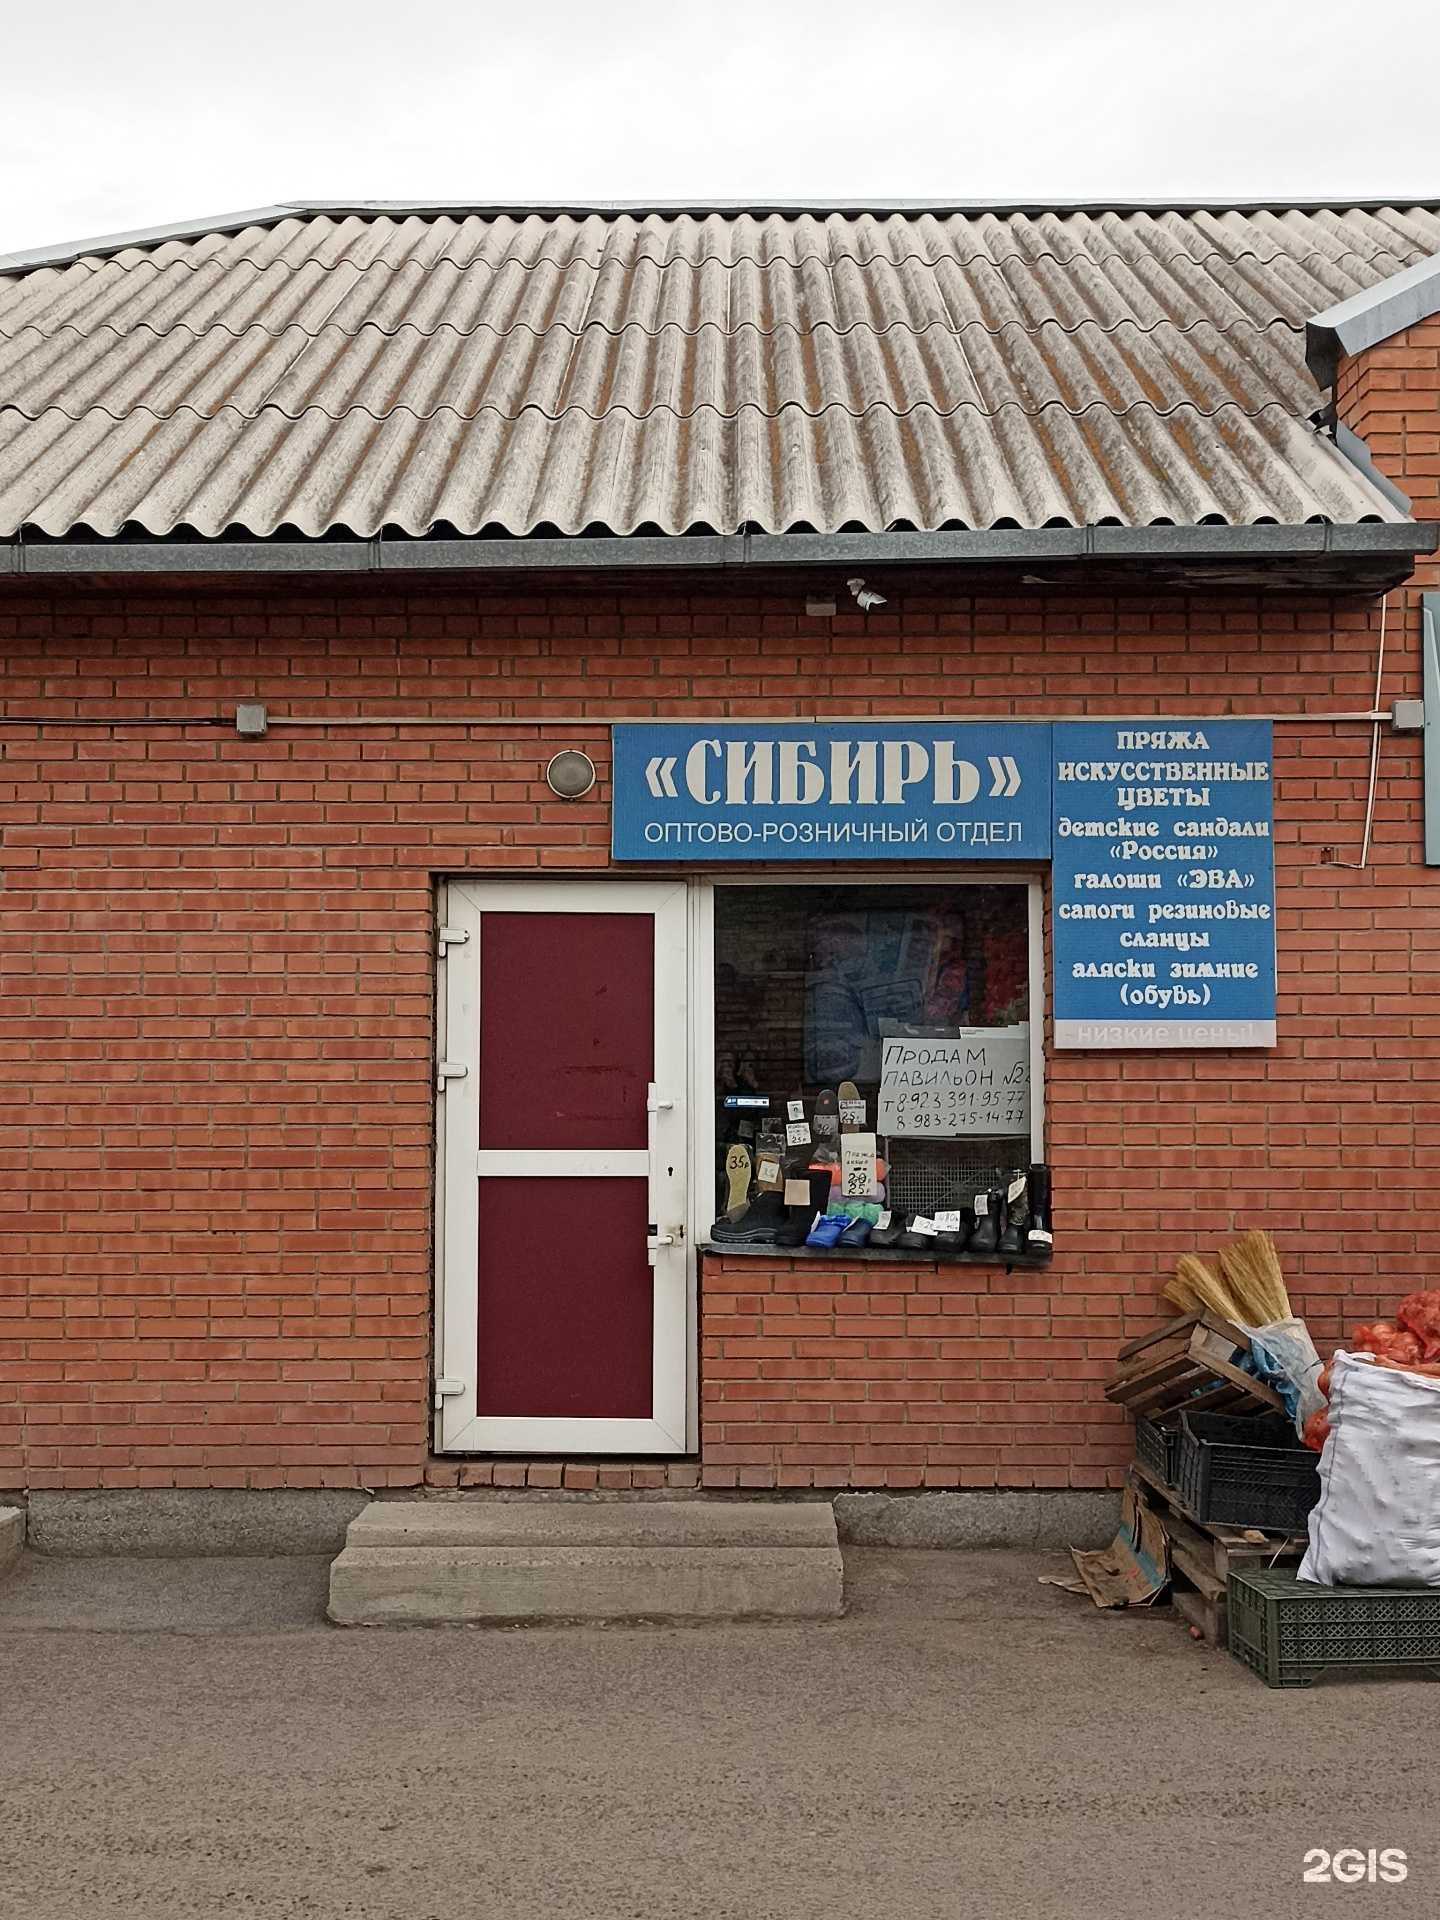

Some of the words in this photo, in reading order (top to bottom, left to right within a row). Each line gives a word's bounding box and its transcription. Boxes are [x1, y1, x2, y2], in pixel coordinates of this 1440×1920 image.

[1117, 731, 1210, 750] ПРЯЖА
[645, 739, 1022, 806] «СИБИРЬ»
[1058, 761, 1270, 781] ИСКУССТВЕННЫЕ
[1117, 787, 1210, 810] ЦВЕТЫ
[645, 819, 928, 843] ОПТОВО-РОЗНИЧНЫЙ
[936, 822, 1022, 845] ОТДЕЛ
[1058, 817, 1160, 836] детские
[1173, 817, 1270, 836] сандали
[1110, 840, 1218, 860] «Россия»
[1074, 873, 1161, 889] галоши
[1177, 869, 1255, 889] «ЭВА»
[1058, 903, 1135, 920] сапоги
[1148, 899, 1271, 923] резиновые
[1120, 931, 1210, 951] сланцы
[1072, 959, 1156, 978] аляски
[1170, 962, 1258, 978] зимние
[1120, 983, 1211, 1009] (обувь)
[883, 1070, 993, 1087] ПАВИЛЬОН
